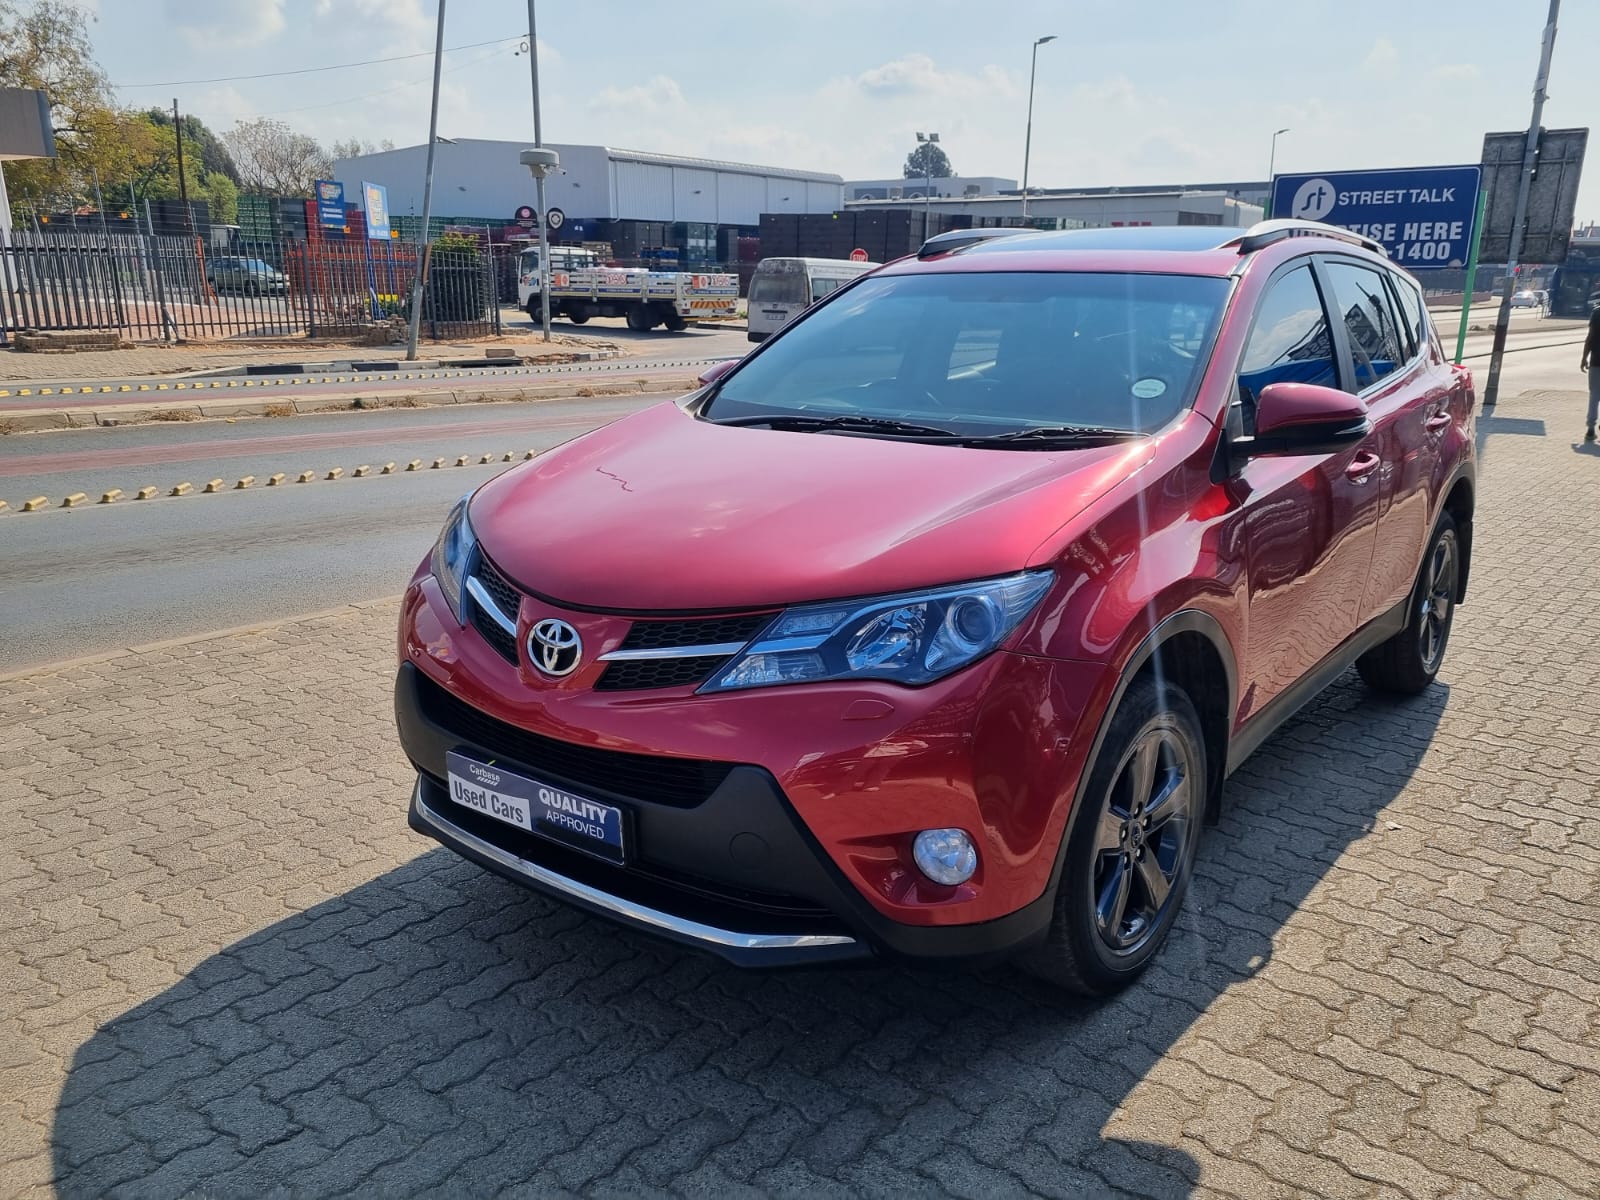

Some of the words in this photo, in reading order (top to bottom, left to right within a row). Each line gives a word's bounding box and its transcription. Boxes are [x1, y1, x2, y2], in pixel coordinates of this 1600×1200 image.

[1338, 189, 1407, 206] STREET
[1409, 187, 1457, 204] TALK
[1403, 221, 1463, 241] HERE
[1384, 242, 1451, 260] -1400
[468, 763, 501, 783] Carbase
[454, 779, 487, 809] Used
[490, 794, 524, 823] Cars
[538, 788, 608, 825] QUALITY
[546, 810, 605, 840] APPROVED
